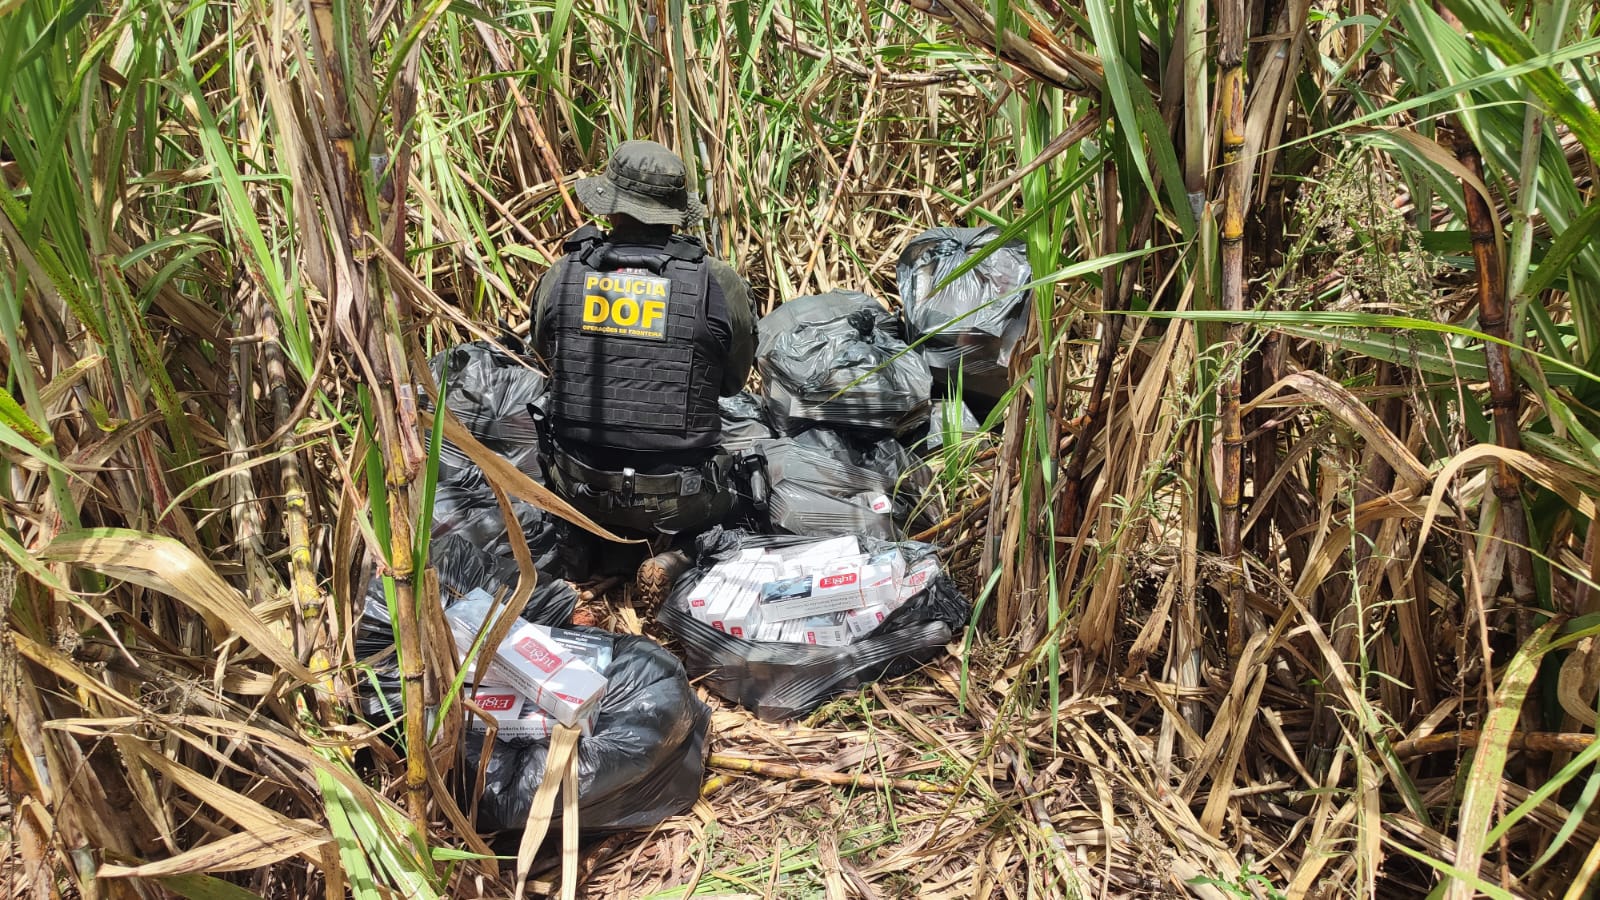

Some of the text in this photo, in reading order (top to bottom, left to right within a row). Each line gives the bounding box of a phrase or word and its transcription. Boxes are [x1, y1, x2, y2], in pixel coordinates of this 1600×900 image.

[583, 295, 666, 329] DOF
[823, 574, 854, 586] Eight
[521, 640, 555, 669] Eight
[474, 696, 510, 709] Eigh
